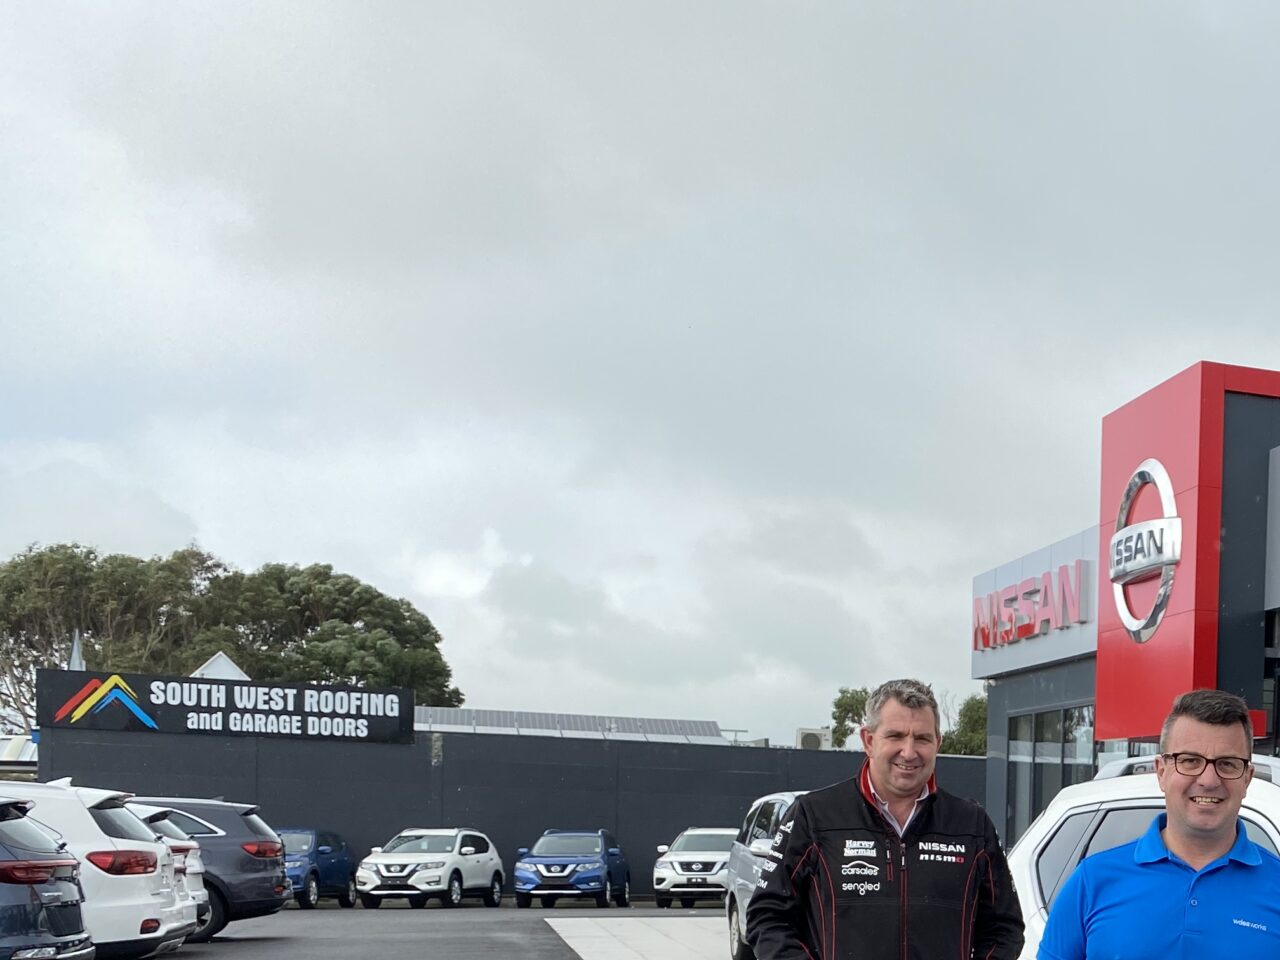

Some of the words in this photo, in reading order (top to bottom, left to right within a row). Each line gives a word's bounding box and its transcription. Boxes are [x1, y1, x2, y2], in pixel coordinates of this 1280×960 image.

[973, 559, 1088, 652] NISSAN
[149, 680, 226, 708] SOUTH
[234, 685, 297, 711] WEST
[304, 689, 399, 717] ROOFING
[186, 711, 223, 731] and
[228, 712, 302, 734] GARAGE
[307, 716, 369, 737] DOORS
[918, 842, 966, 853] NISSAN
[920, 853, 965, 864] nismo
[841, 866, 878, 876] carsales
[842, 881, 881, 895] sengled
